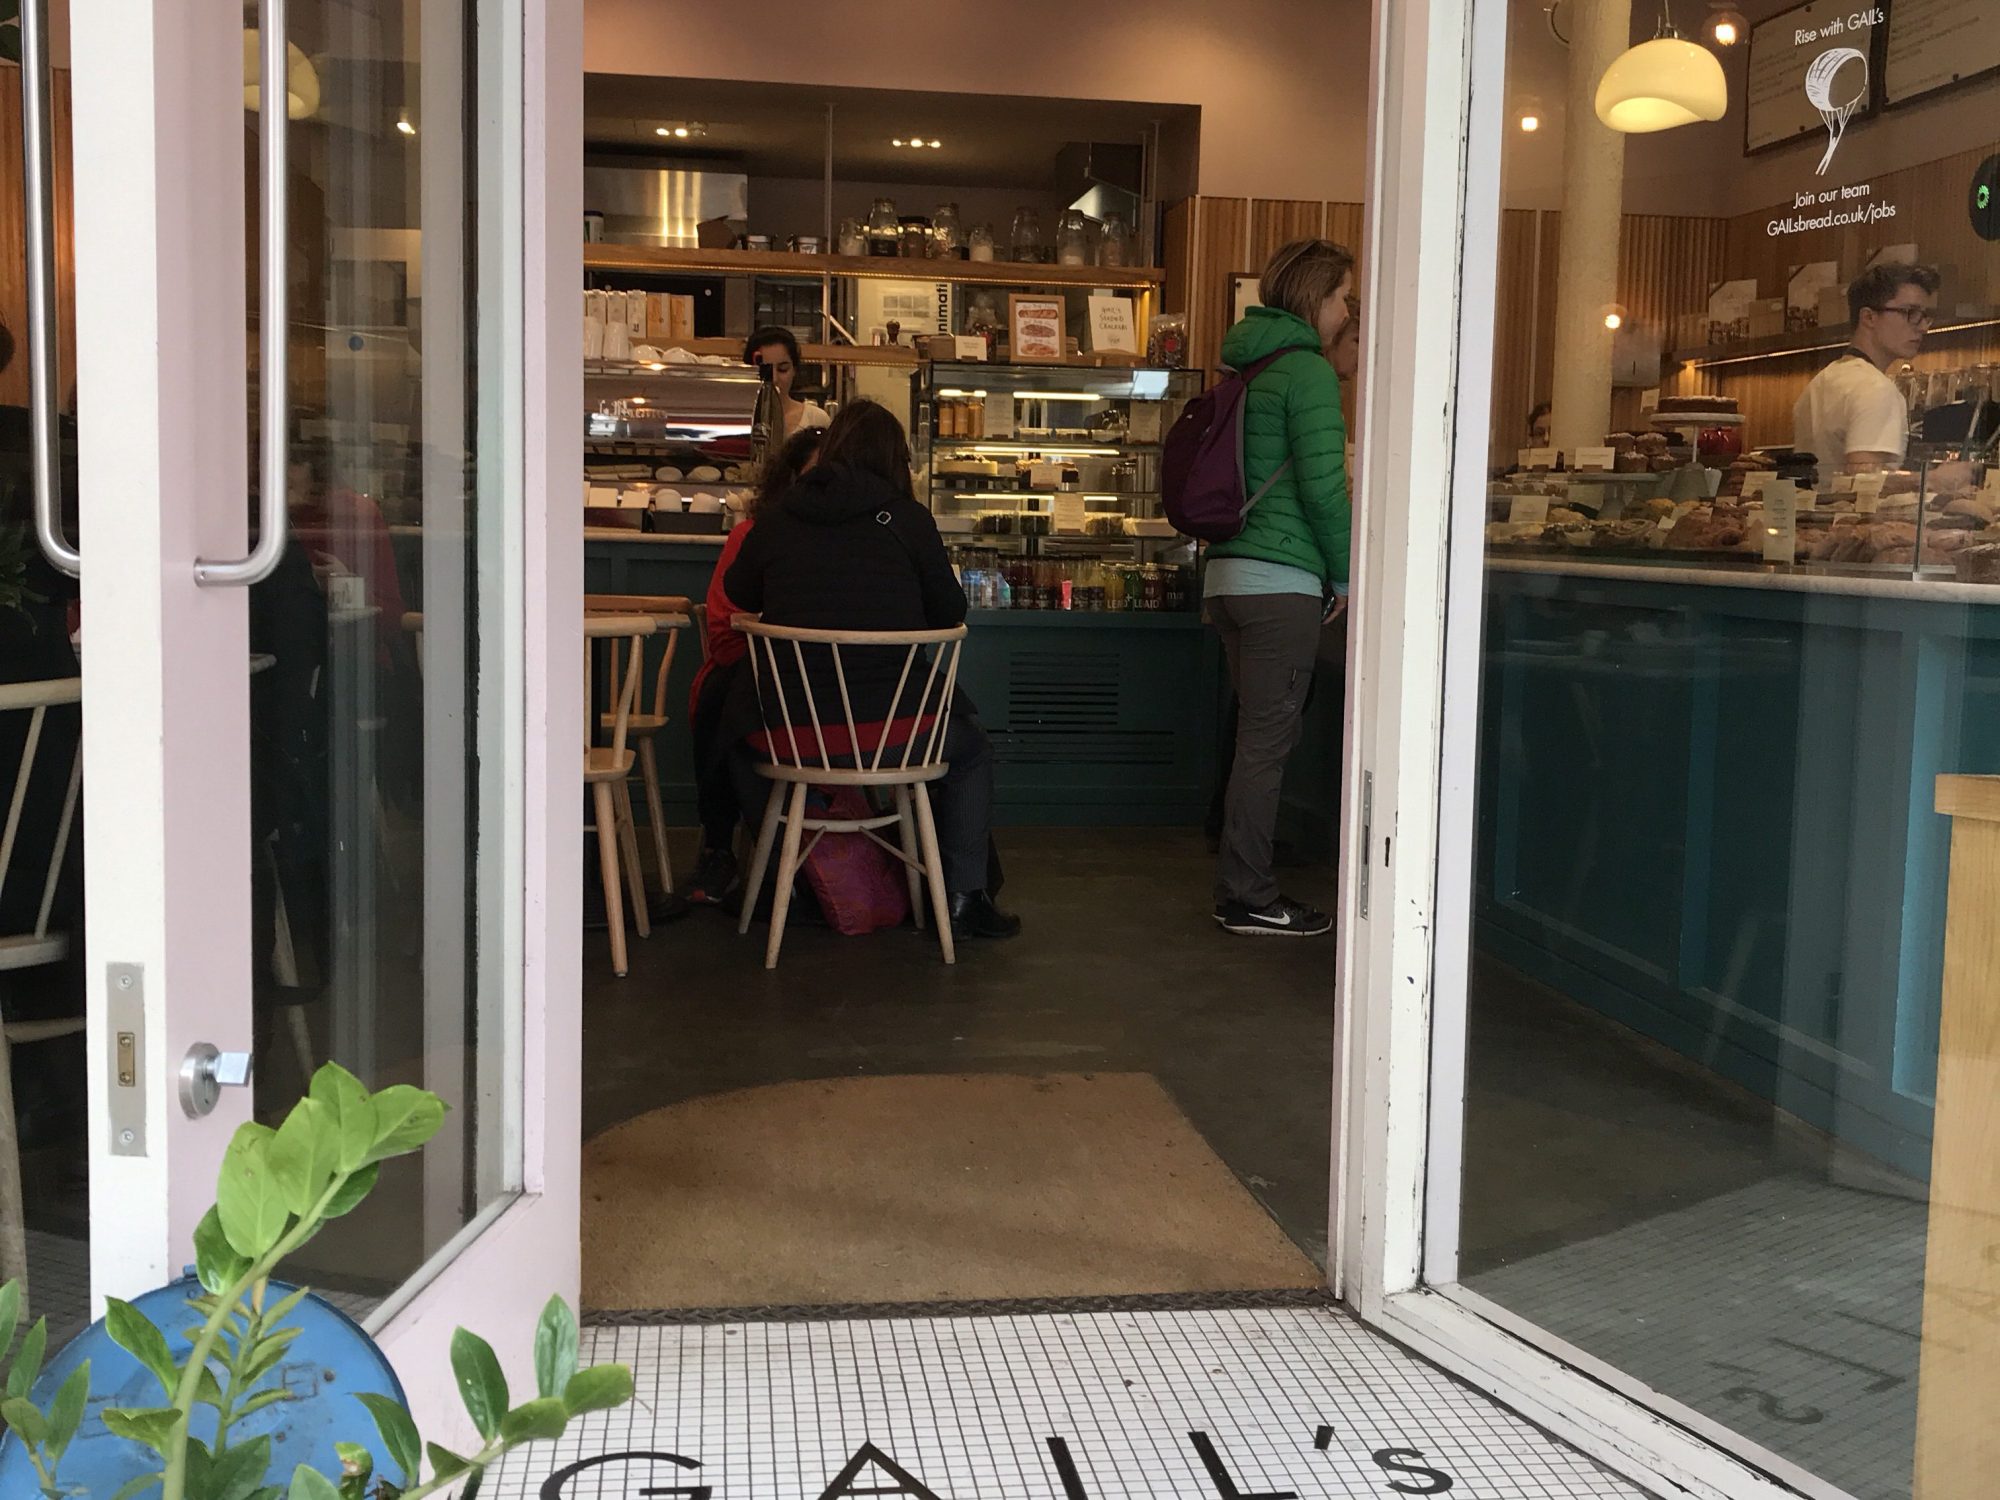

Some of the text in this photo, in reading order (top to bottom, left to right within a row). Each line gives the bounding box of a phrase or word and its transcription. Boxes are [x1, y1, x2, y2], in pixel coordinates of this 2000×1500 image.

[1794, 7, 1885, 46] Rise with GAIL's
[1792, 183, 1871, 210] Join our team
[1766, 200, 1897, 237] GAILsbread.co.uk/jobs
